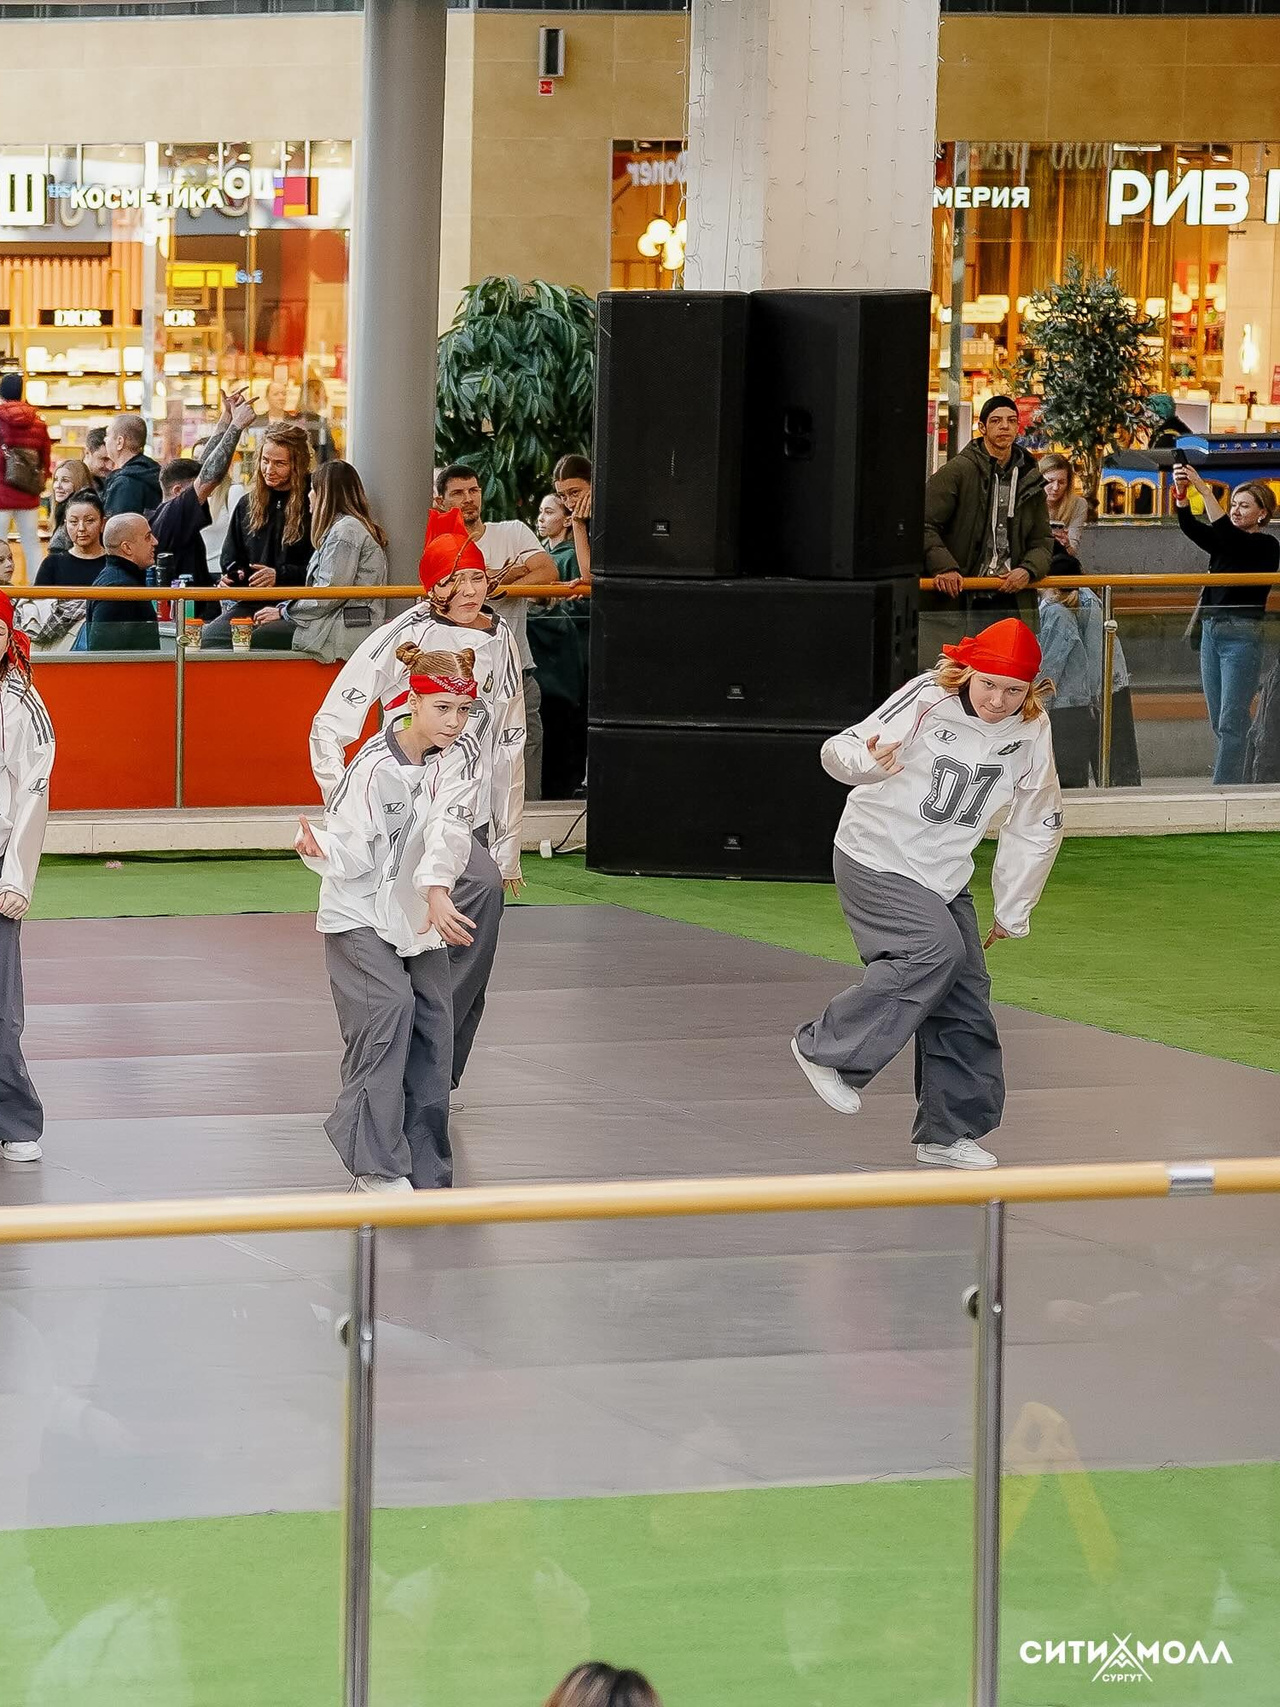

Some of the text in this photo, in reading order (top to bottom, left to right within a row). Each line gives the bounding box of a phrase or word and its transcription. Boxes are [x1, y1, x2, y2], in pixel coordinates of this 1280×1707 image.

[70, 187, 224, 210] КОСМЕТИКА
[1108, 169, 1251, 226] РИВ
[919, 754, 1005, 829] 07
